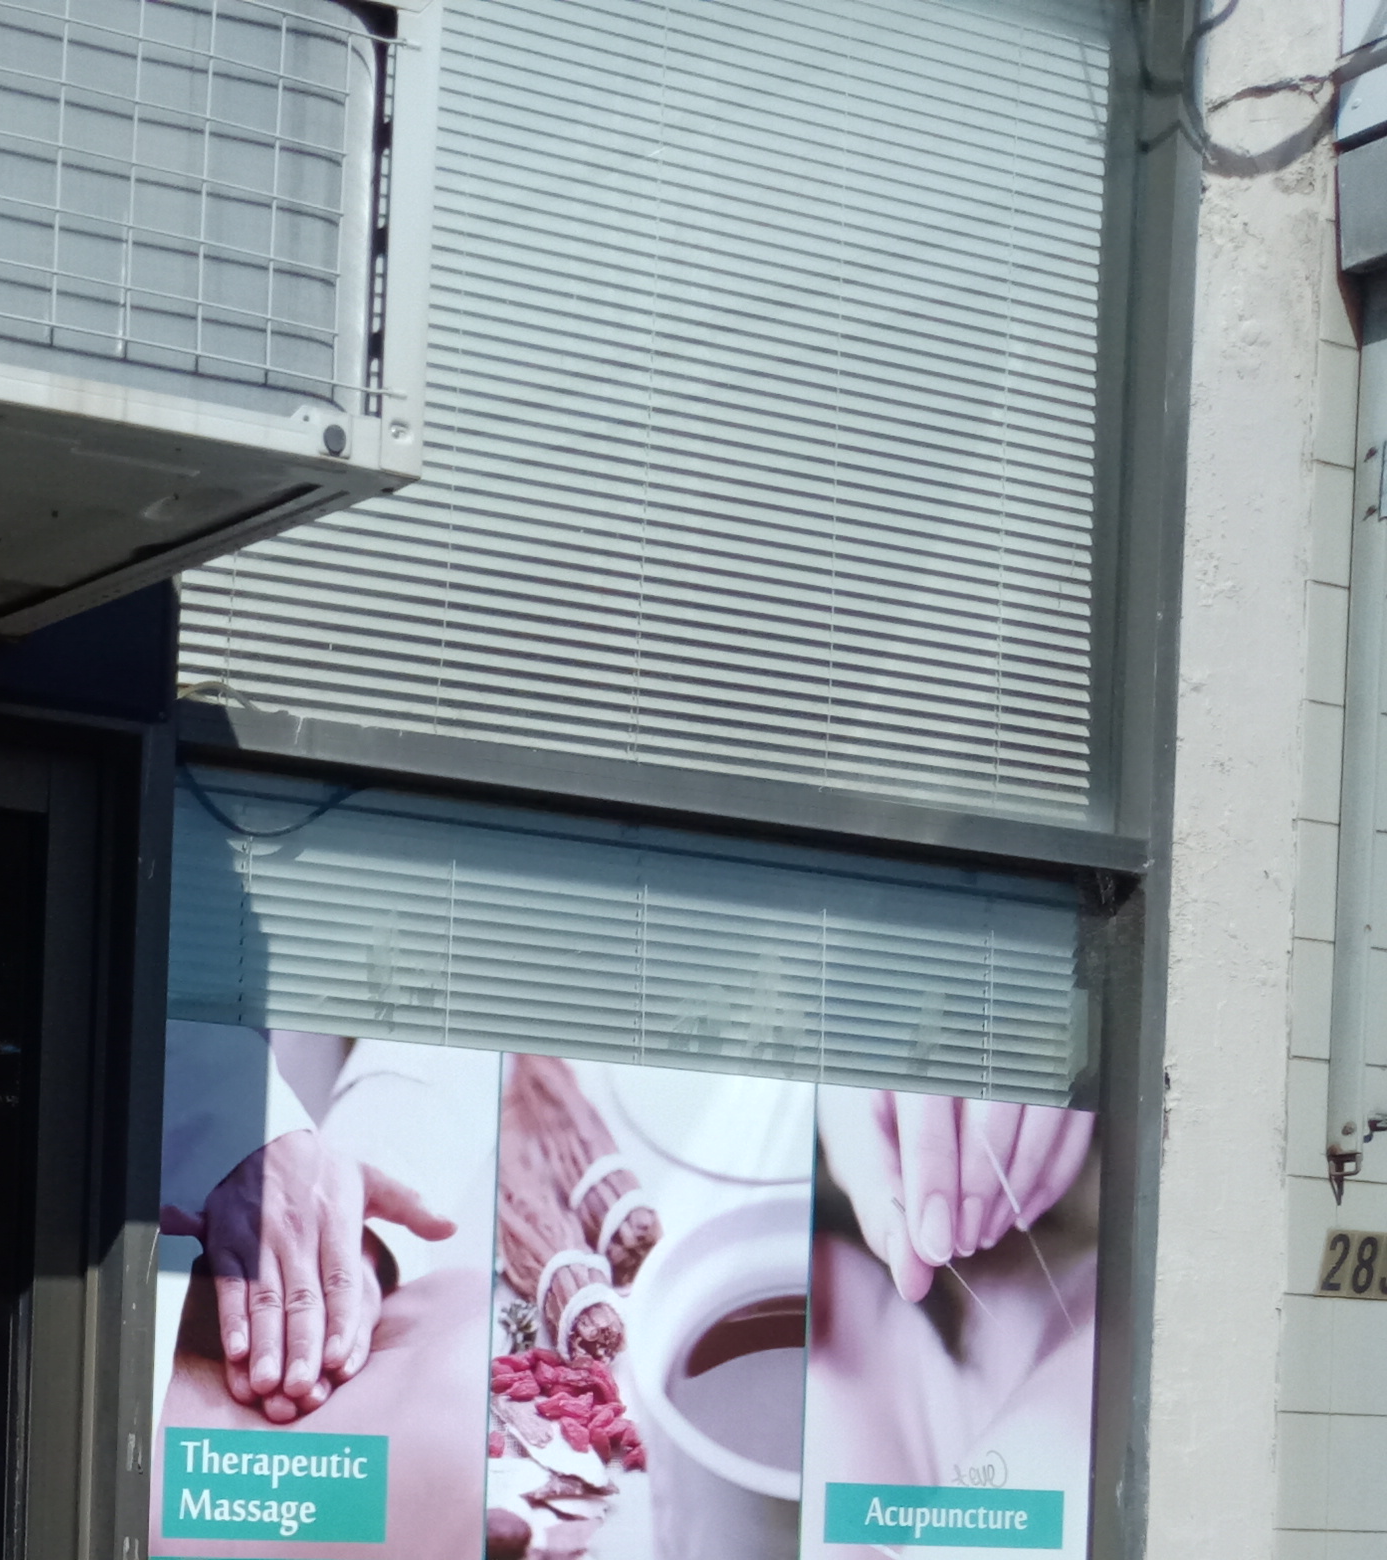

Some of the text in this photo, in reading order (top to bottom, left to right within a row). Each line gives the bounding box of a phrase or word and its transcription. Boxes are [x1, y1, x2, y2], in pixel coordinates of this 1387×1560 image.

[180, 1438, 368, 1489] Therapeutic
[178, 1488, 316, 1536] Massage
[864, 1496, 1028, 1538] Acupuncture
